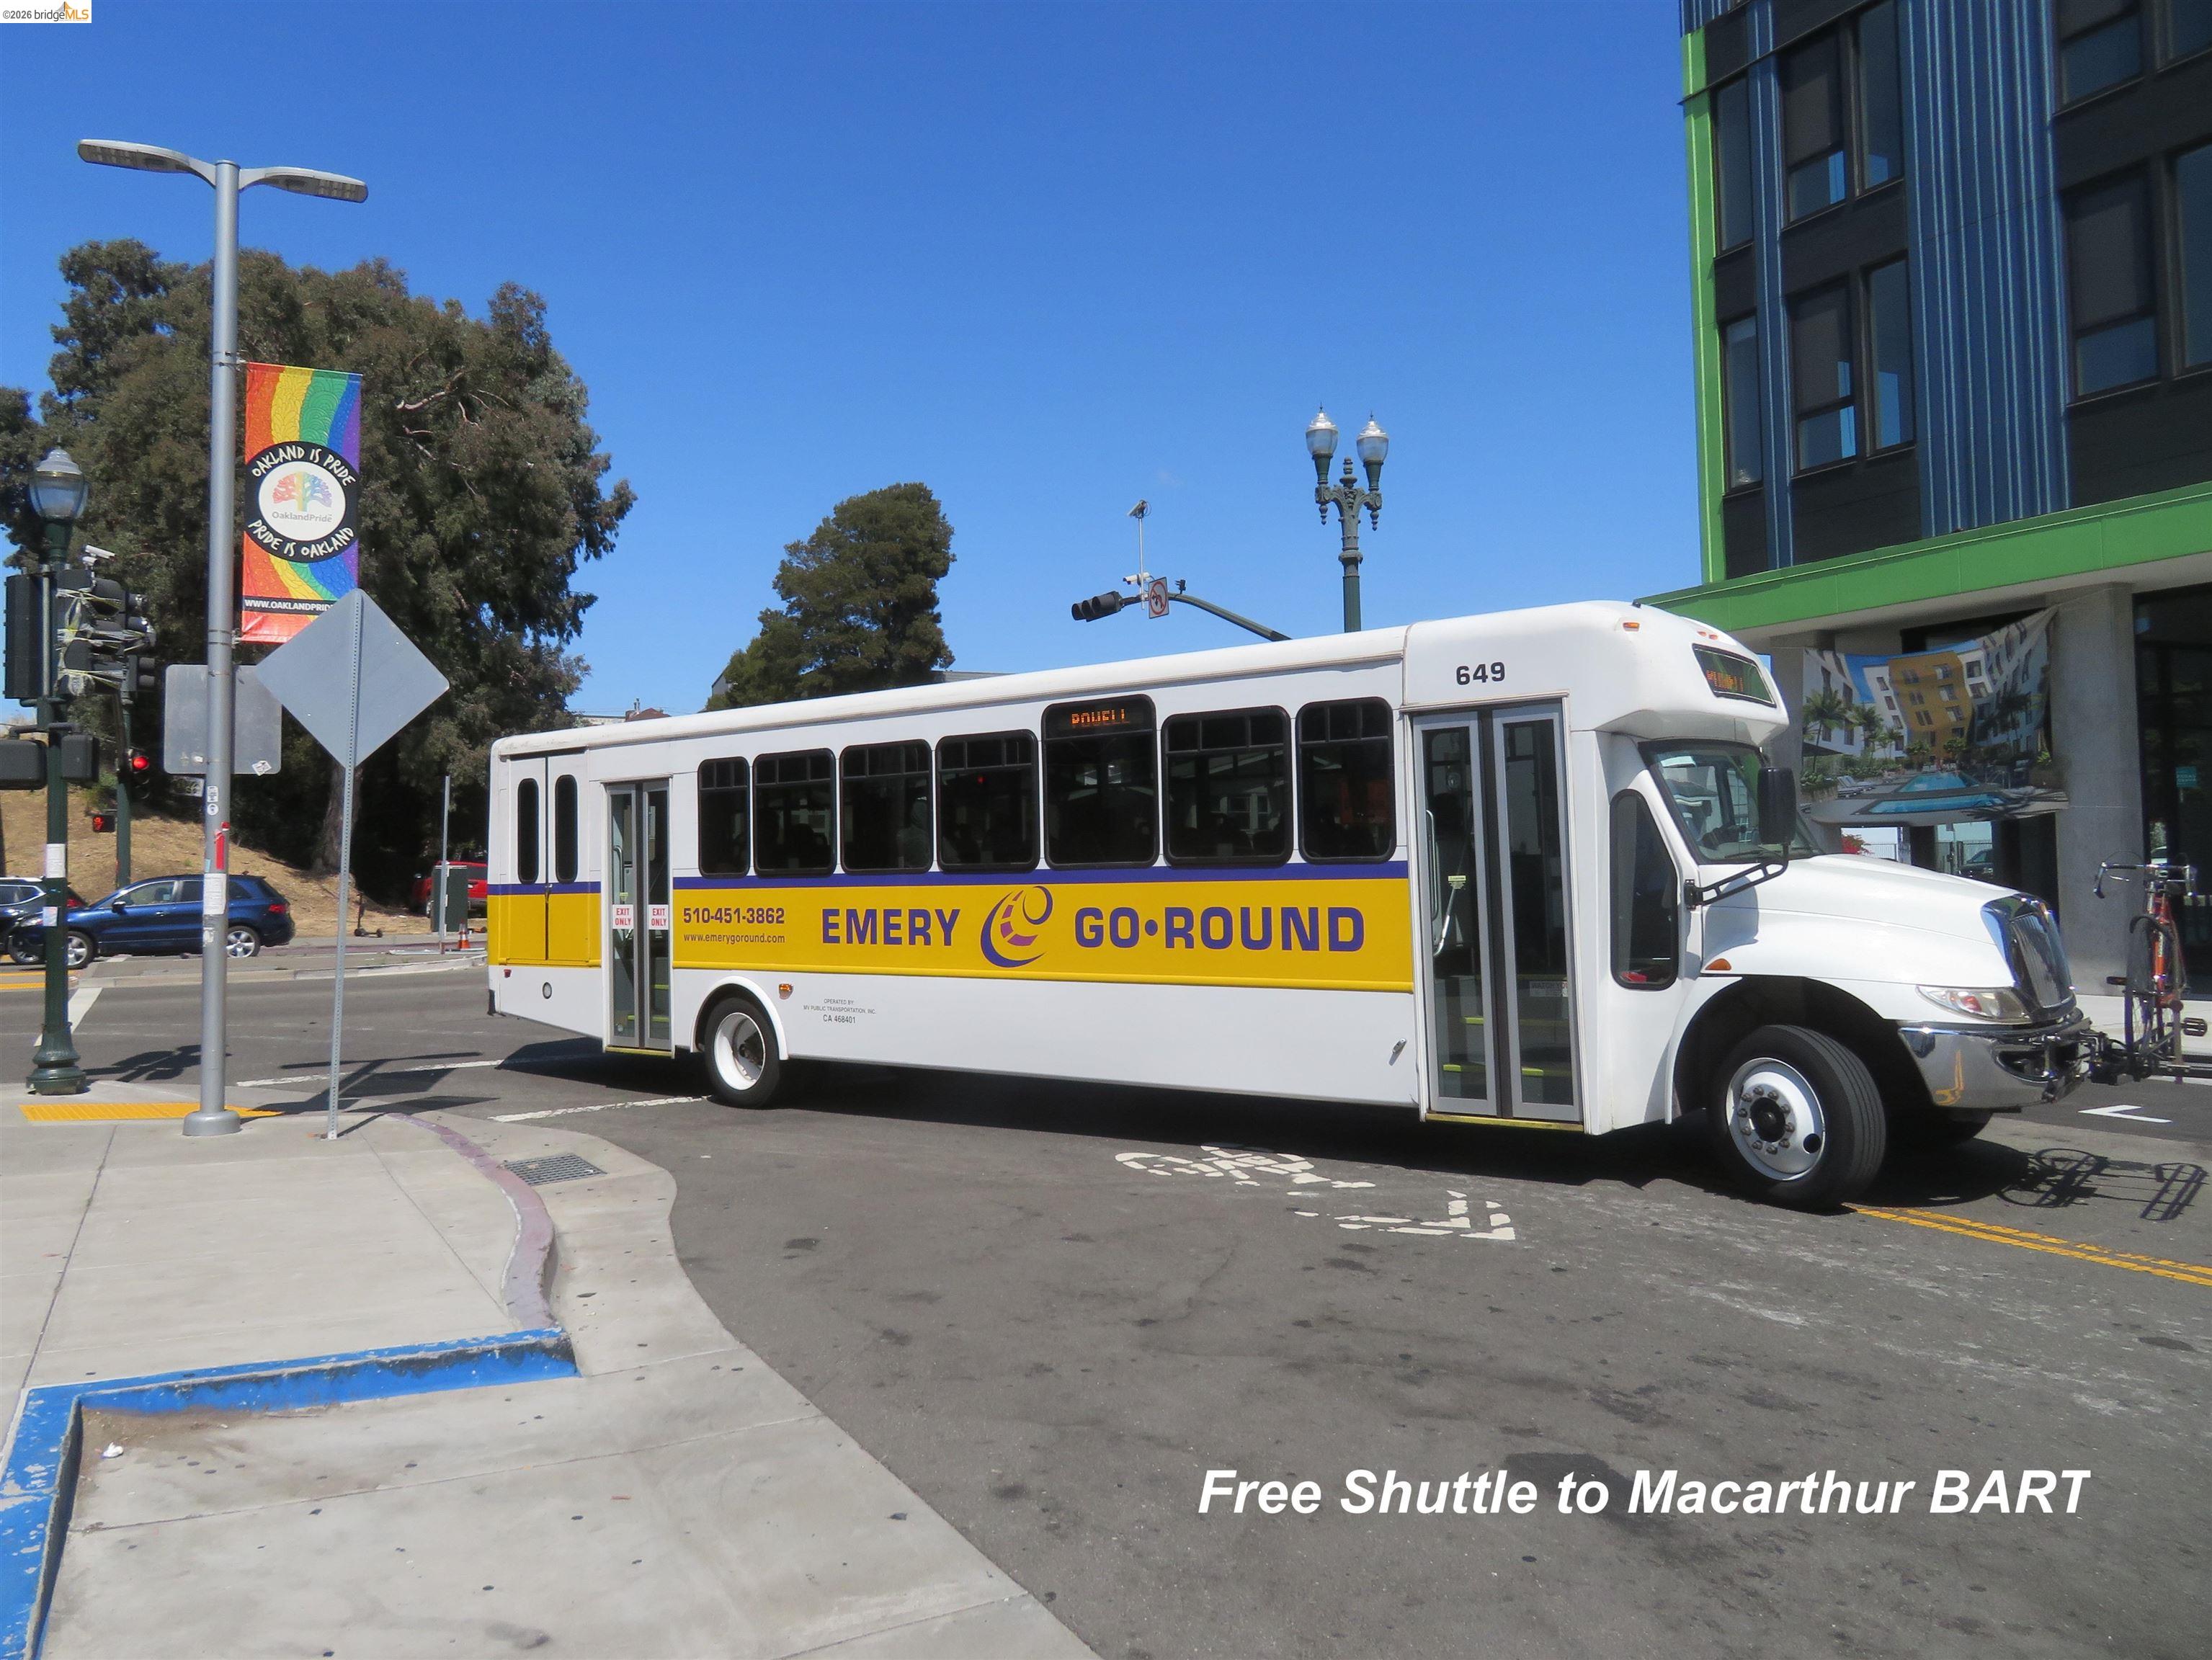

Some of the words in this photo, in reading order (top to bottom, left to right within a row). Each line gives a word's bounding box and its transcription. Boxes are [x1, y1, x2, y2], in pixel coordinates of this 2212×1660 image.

[252, 446, 305, 477] OAKLAND
[310, 449, 322, 463] IS
[324, 454, 356, 486] PRIDE
[248, 519, 282, 550] PRIDE
[284, 543, 296, 557] IS
[300, 527, 354, 558] OAKLAND
[244, 599, 334, 612] WWW.OAKLANDPRID
[1456, 661, 1505, 685] 649
[651, 918, 667, 927] ONLY
[683, 907, 785, 924] 510-451-3862
[822, 908, 960, 946] EMERY
[684, 932, 785, 945] www.emerygoround.com
[823, 1014, 832, 1022] CA
[834, 1014, 856, 1024] 468401
